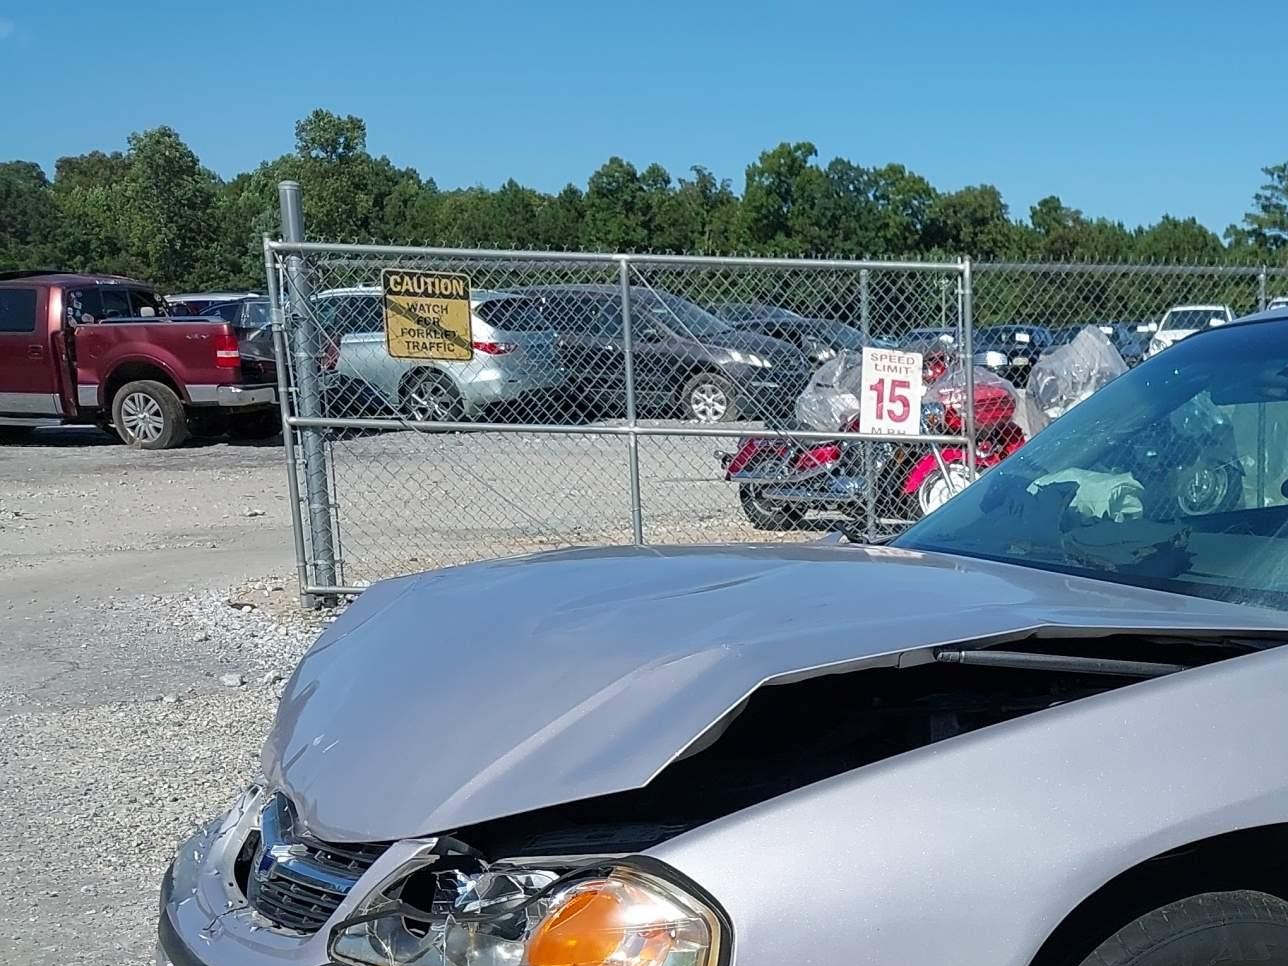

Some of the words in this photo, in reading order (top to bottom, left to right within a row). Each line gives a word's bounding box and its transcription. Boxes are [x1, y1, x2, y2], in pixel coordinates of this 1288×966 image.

[389, 275, 465, 296] CAUTION
[407, 302, 449, 315] WATCH
[416, 315, 441, 328] FOR
[405, 340, 455, 353] TRAFFIC
[870, 352, 916, 365] SPEED
[874, 363, 912, 375] LIMIT
[869, 378, 911, 423] 15
